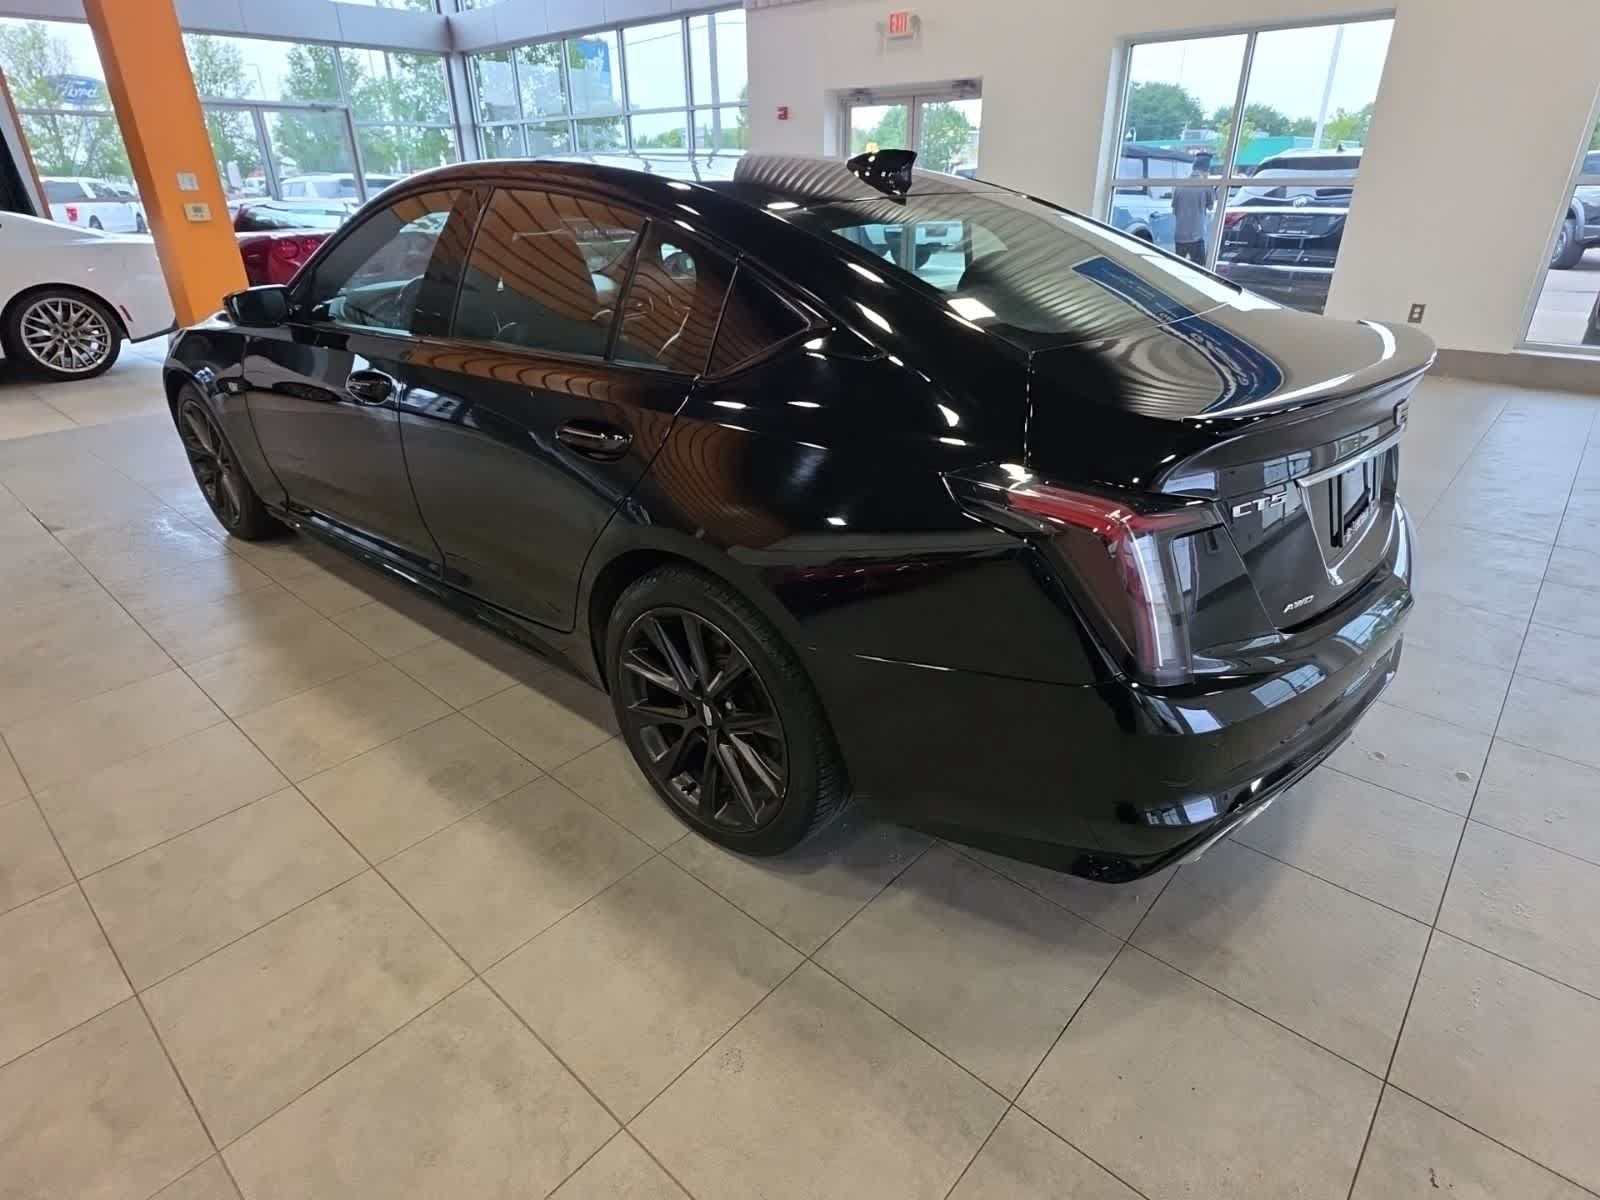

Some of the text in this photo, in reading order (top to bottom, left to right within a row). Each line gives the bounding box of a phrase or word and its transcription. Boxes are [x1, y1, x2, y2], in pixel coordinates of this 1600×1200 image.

[890, 13, 909, 33] EXIT
[56, 79, 98, 98] Ford
[1283, 594, 1314, 613] AWD
